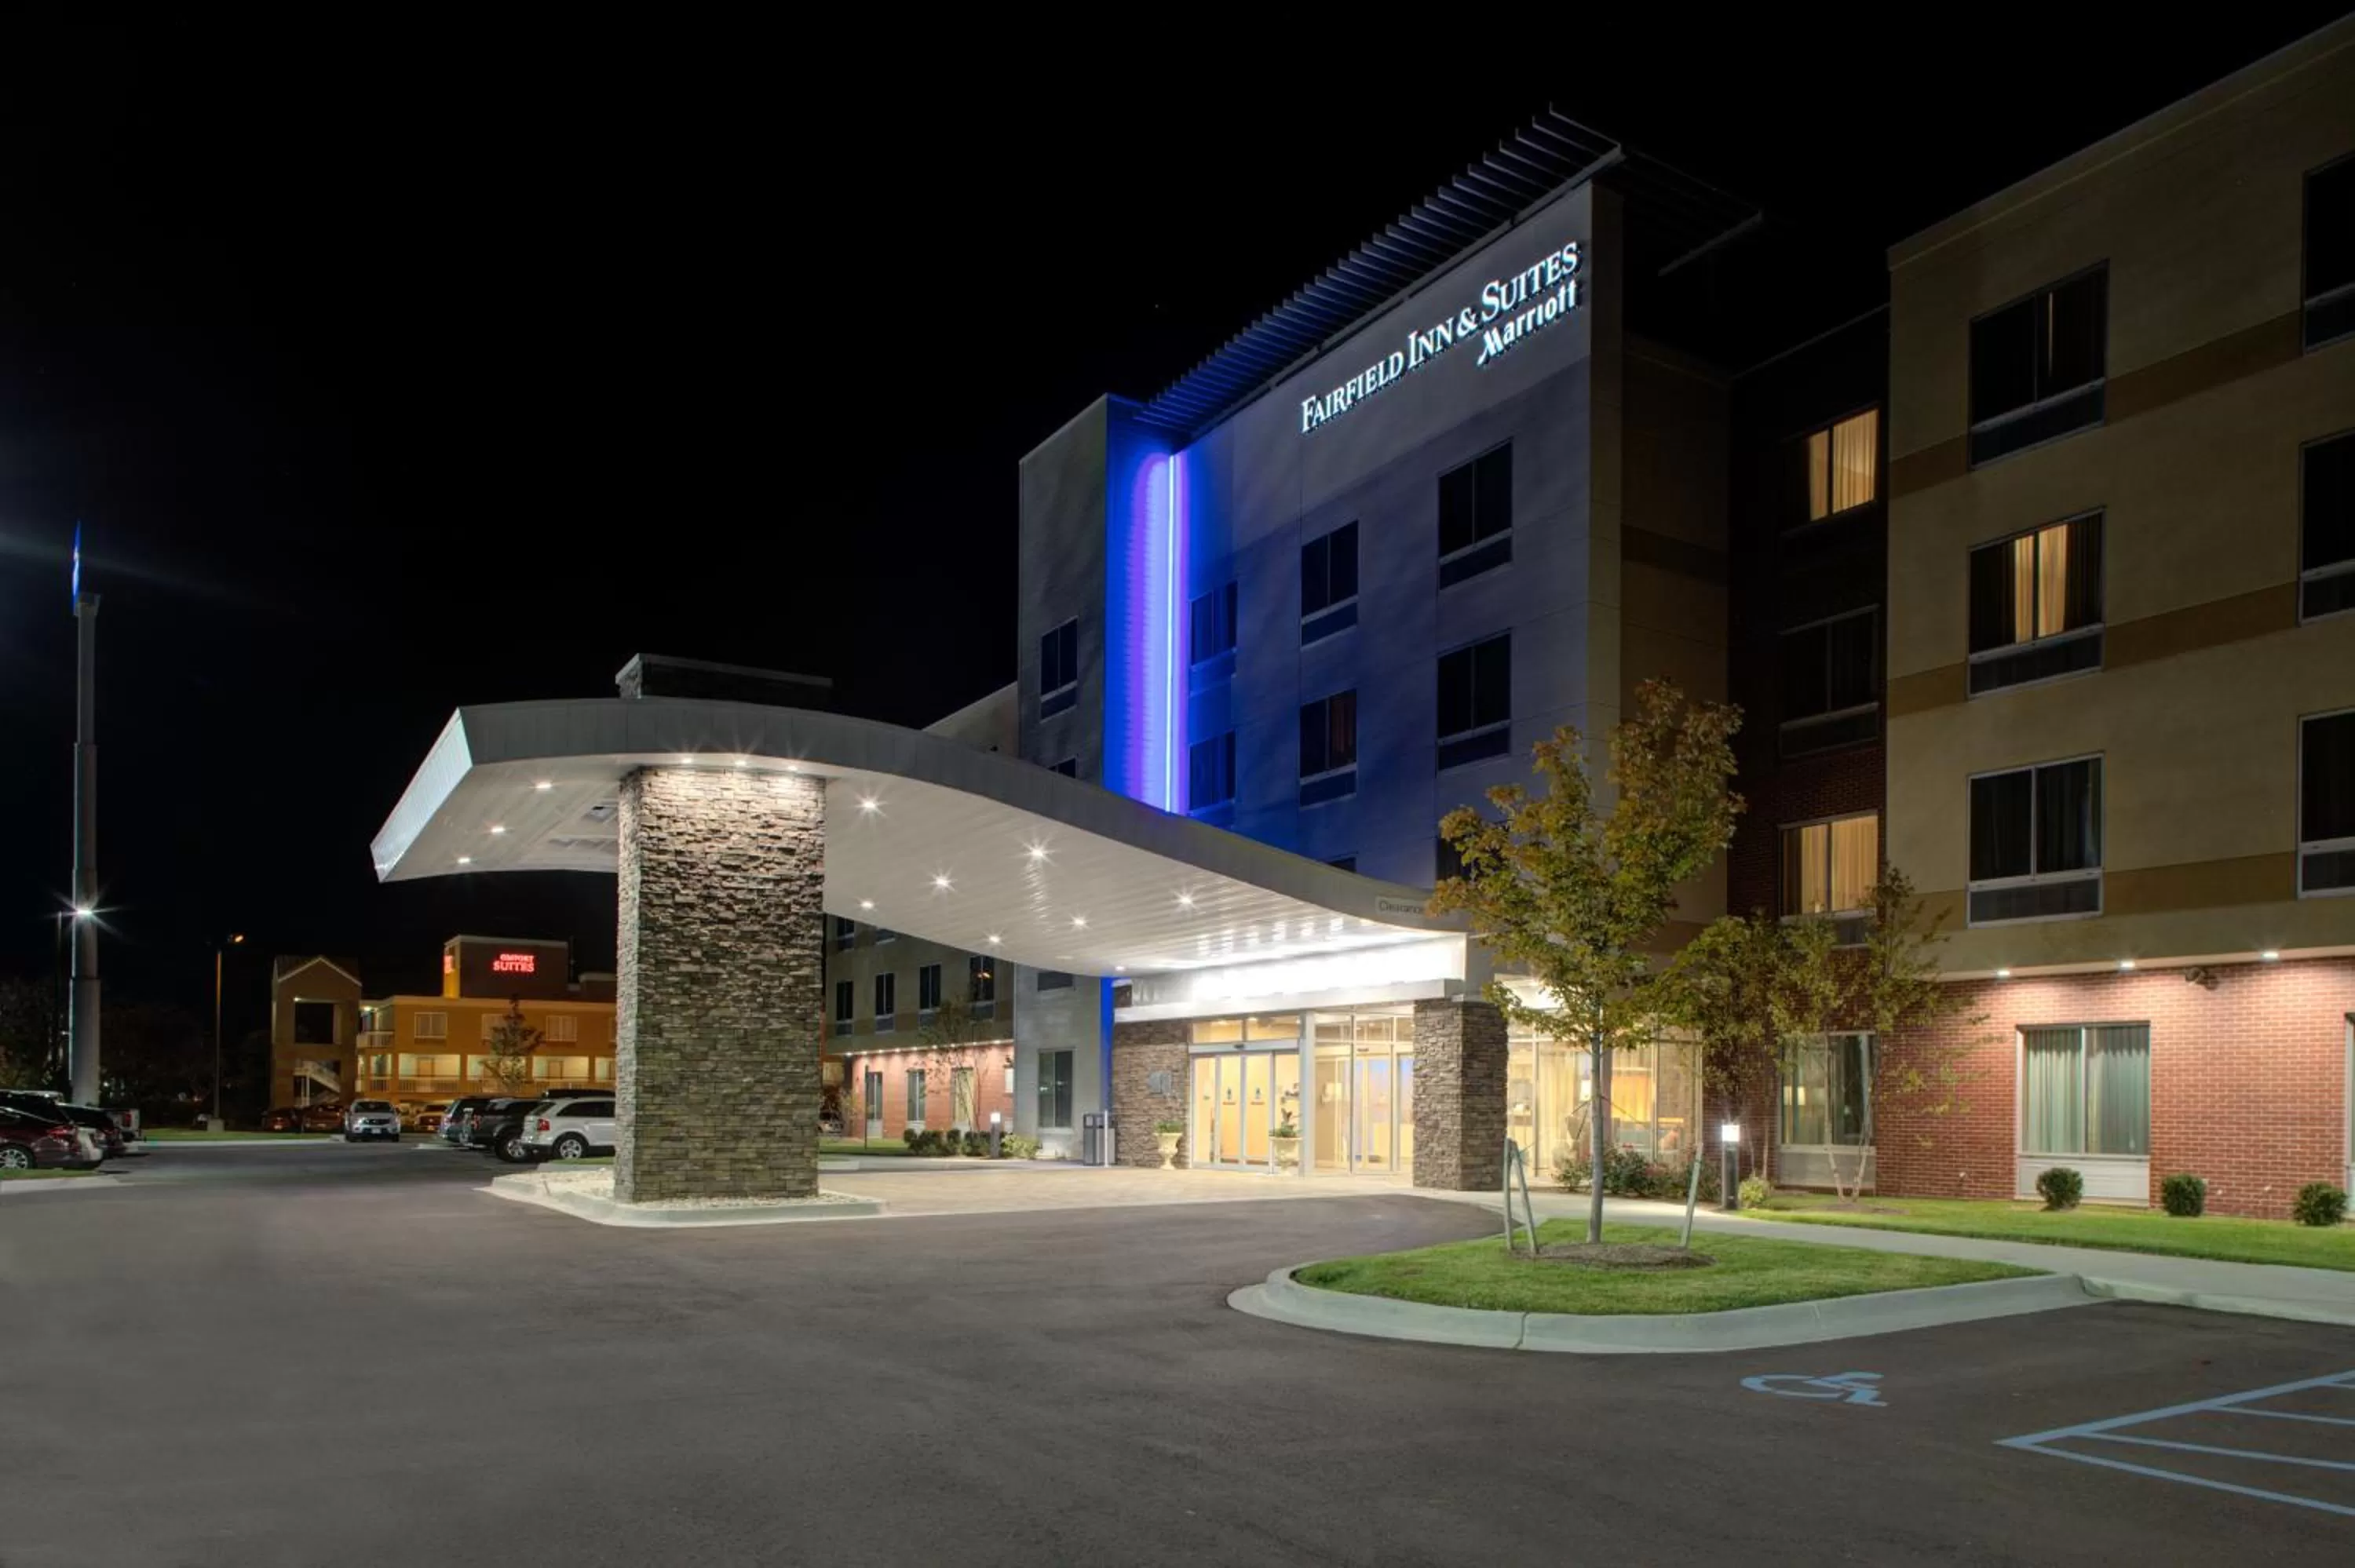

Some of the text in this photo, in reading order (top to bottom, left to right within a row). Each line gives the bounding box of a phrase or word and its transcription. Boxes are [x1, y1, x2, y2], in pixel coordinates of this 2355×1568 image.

[1301, 240, 1579, 433] FAIRFIELD INN & SUITES
[1477, 279, 1579, 366] Marriott
[494, 961, 535, 972] SUITES
